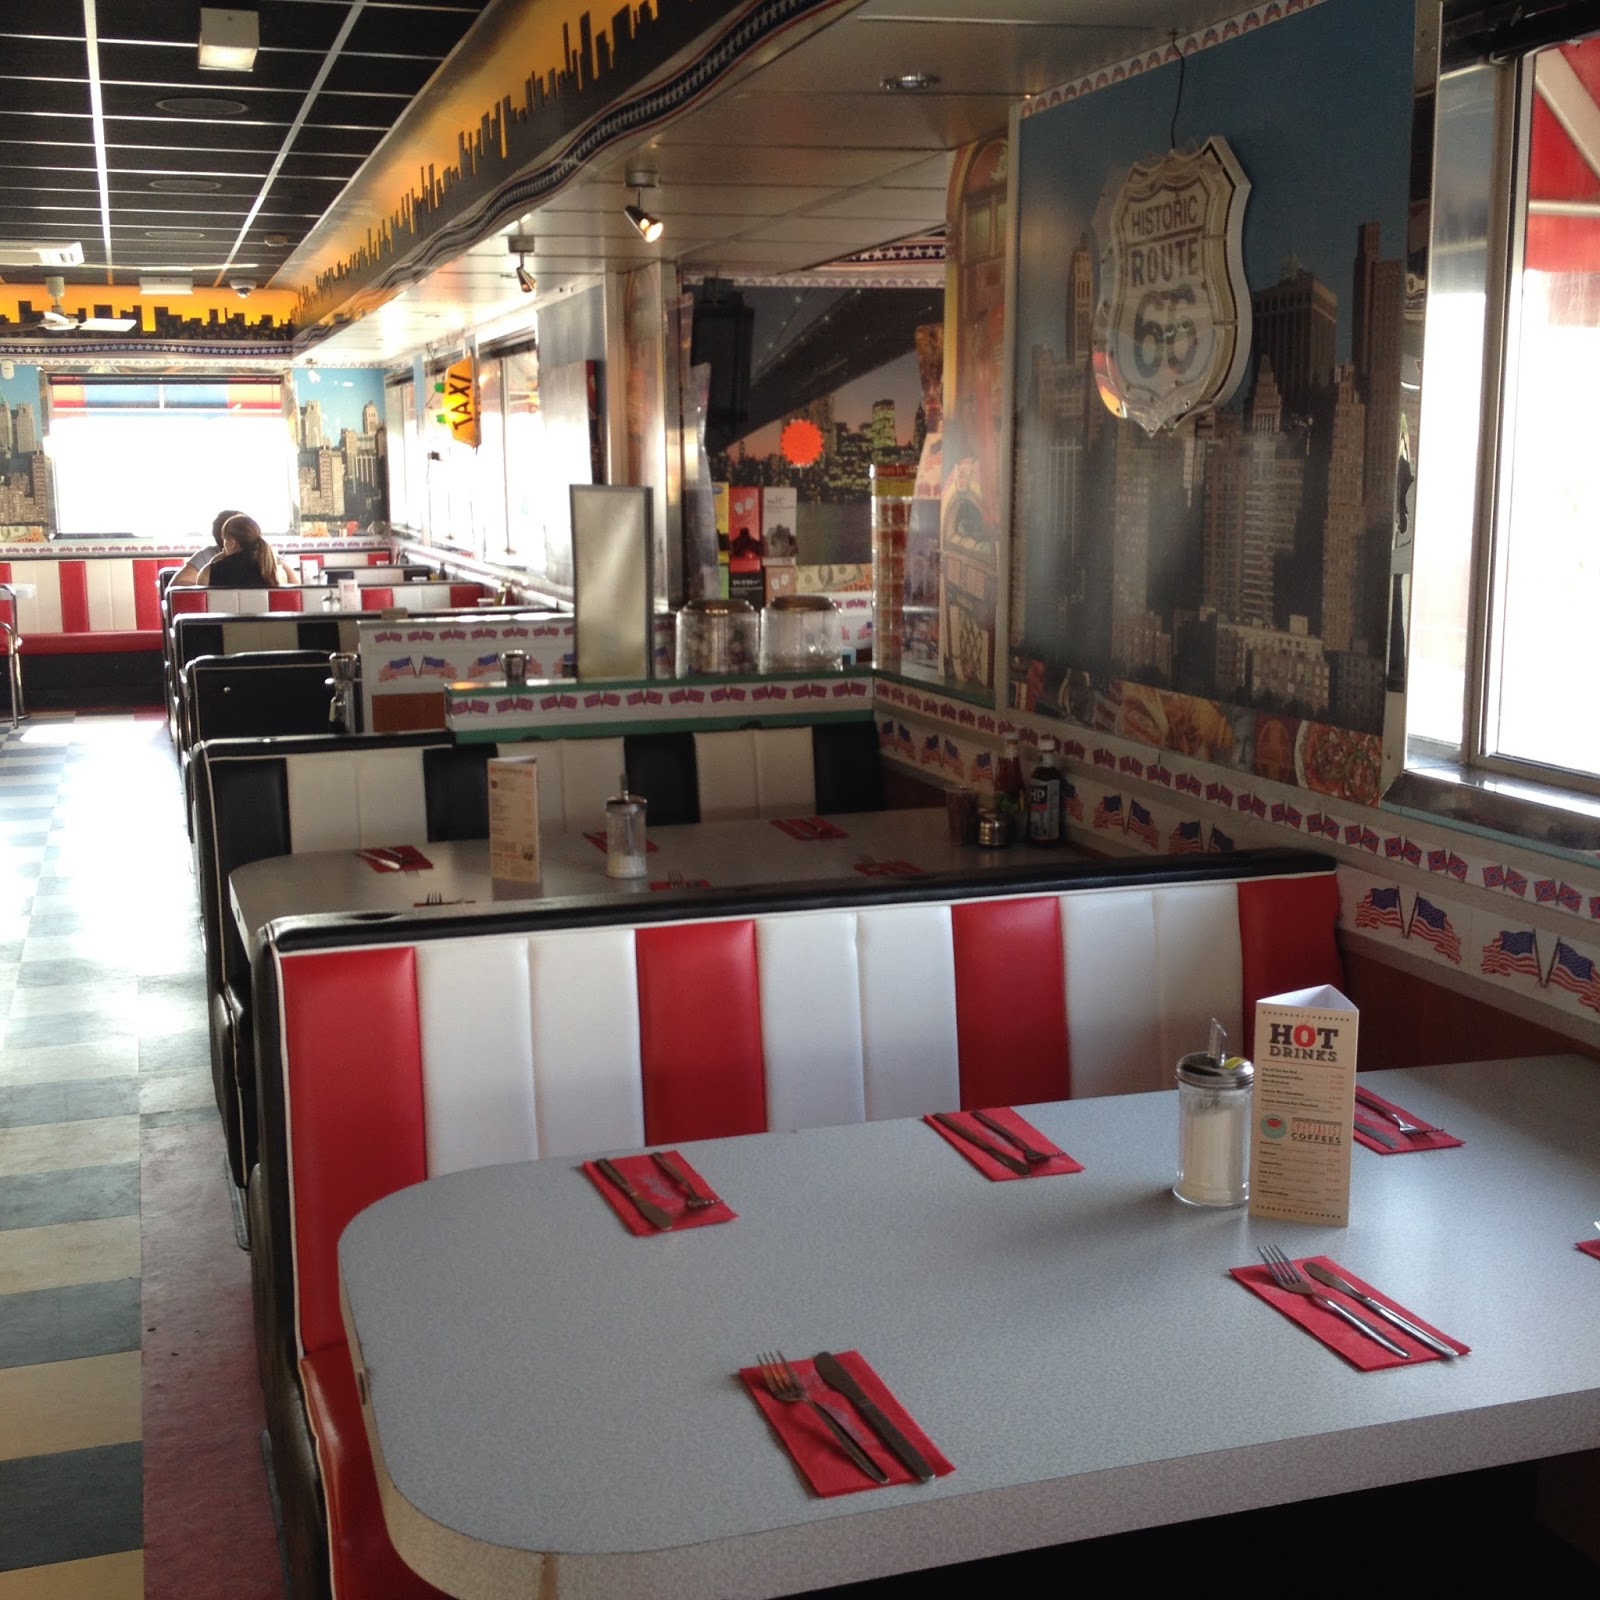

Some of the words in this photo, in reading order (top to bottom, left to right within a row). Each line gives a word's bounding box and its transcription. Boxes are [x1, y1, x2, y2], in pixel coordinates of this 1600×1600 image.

[1130, 195, 1198, 237] HISTORIC
[1130, 238, 1200, 288] ROUTE
[1133, 284, 1198, 379] 66
[448, 373, 473, 431] TAXI
[1269, 1023, 1339, 1049] HOT
[1269, 1045, 1338, 1062] DRINKS
[1290, 1132, 1342, 1144] COFFEES
